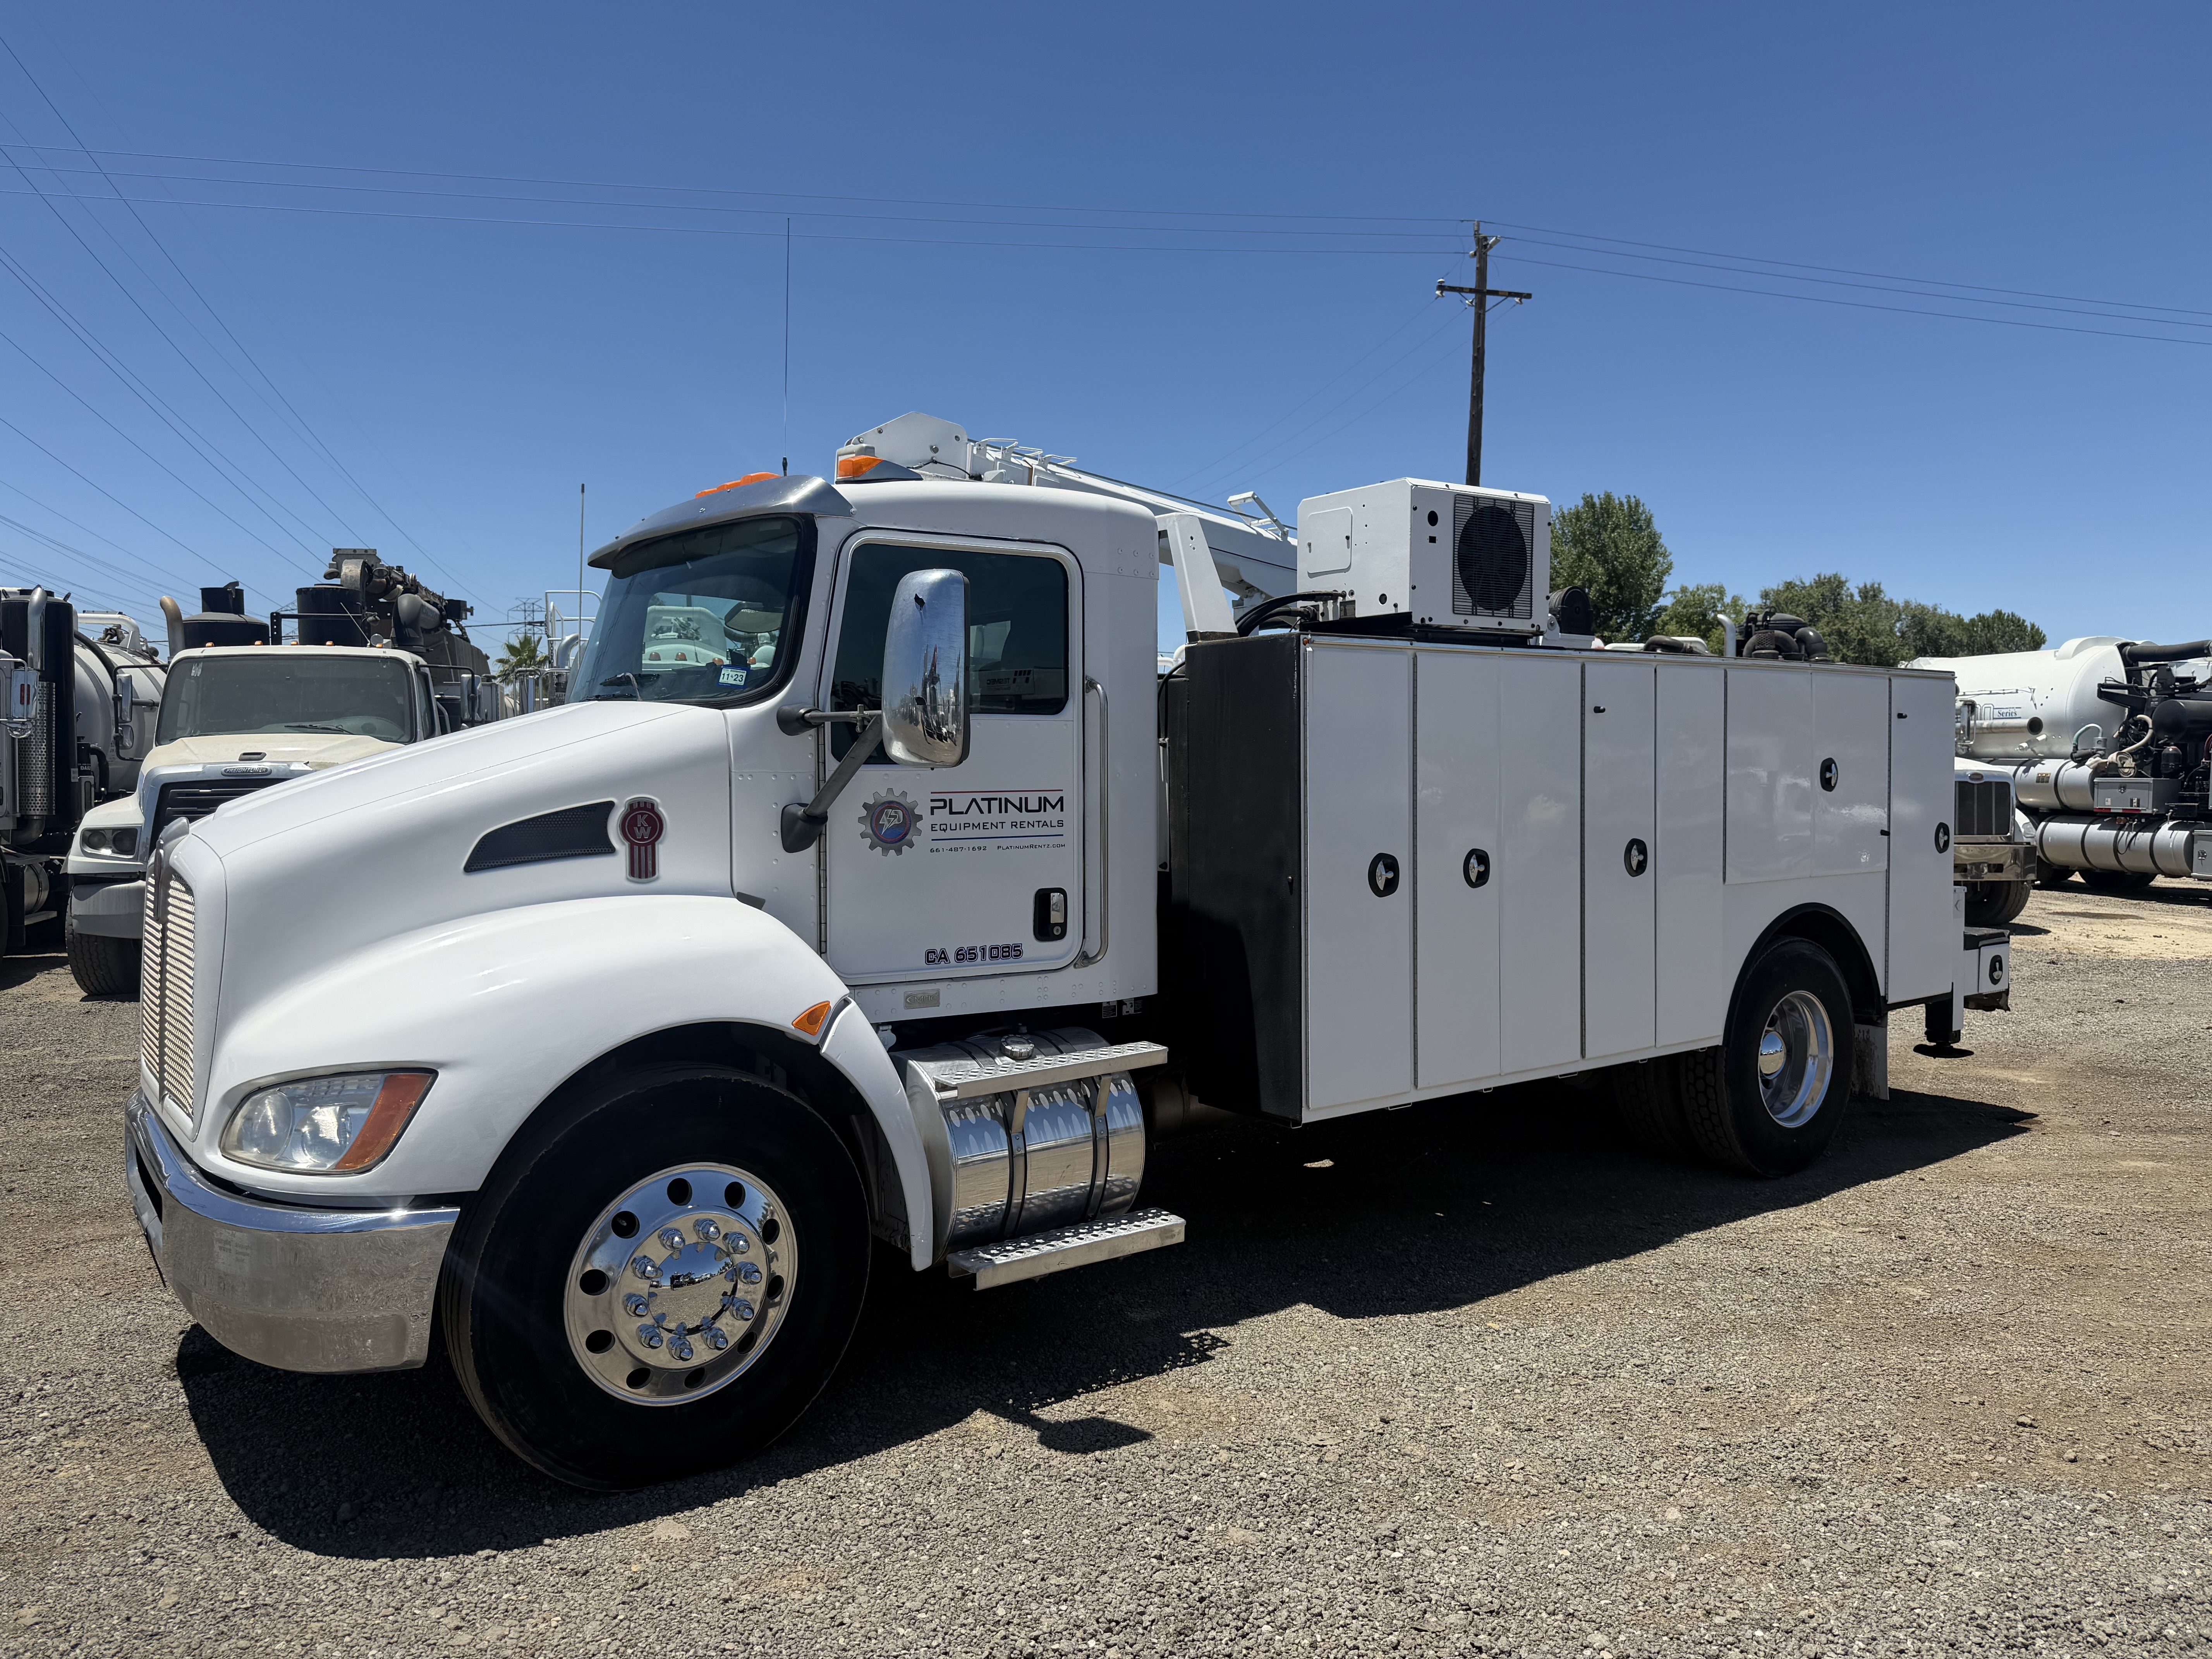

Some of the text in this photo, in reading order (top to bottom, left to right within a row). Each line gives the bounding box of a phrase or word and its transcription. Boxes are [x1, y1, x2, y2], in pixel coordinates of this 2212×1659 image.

[733, 674, 744, 682] 23
[930, 796, 1063, 815] PLATINUM
[931, 820, 1064, 833] EQUIPMENT RENTALS
[925, 943, 1023, 965] CA 651085
